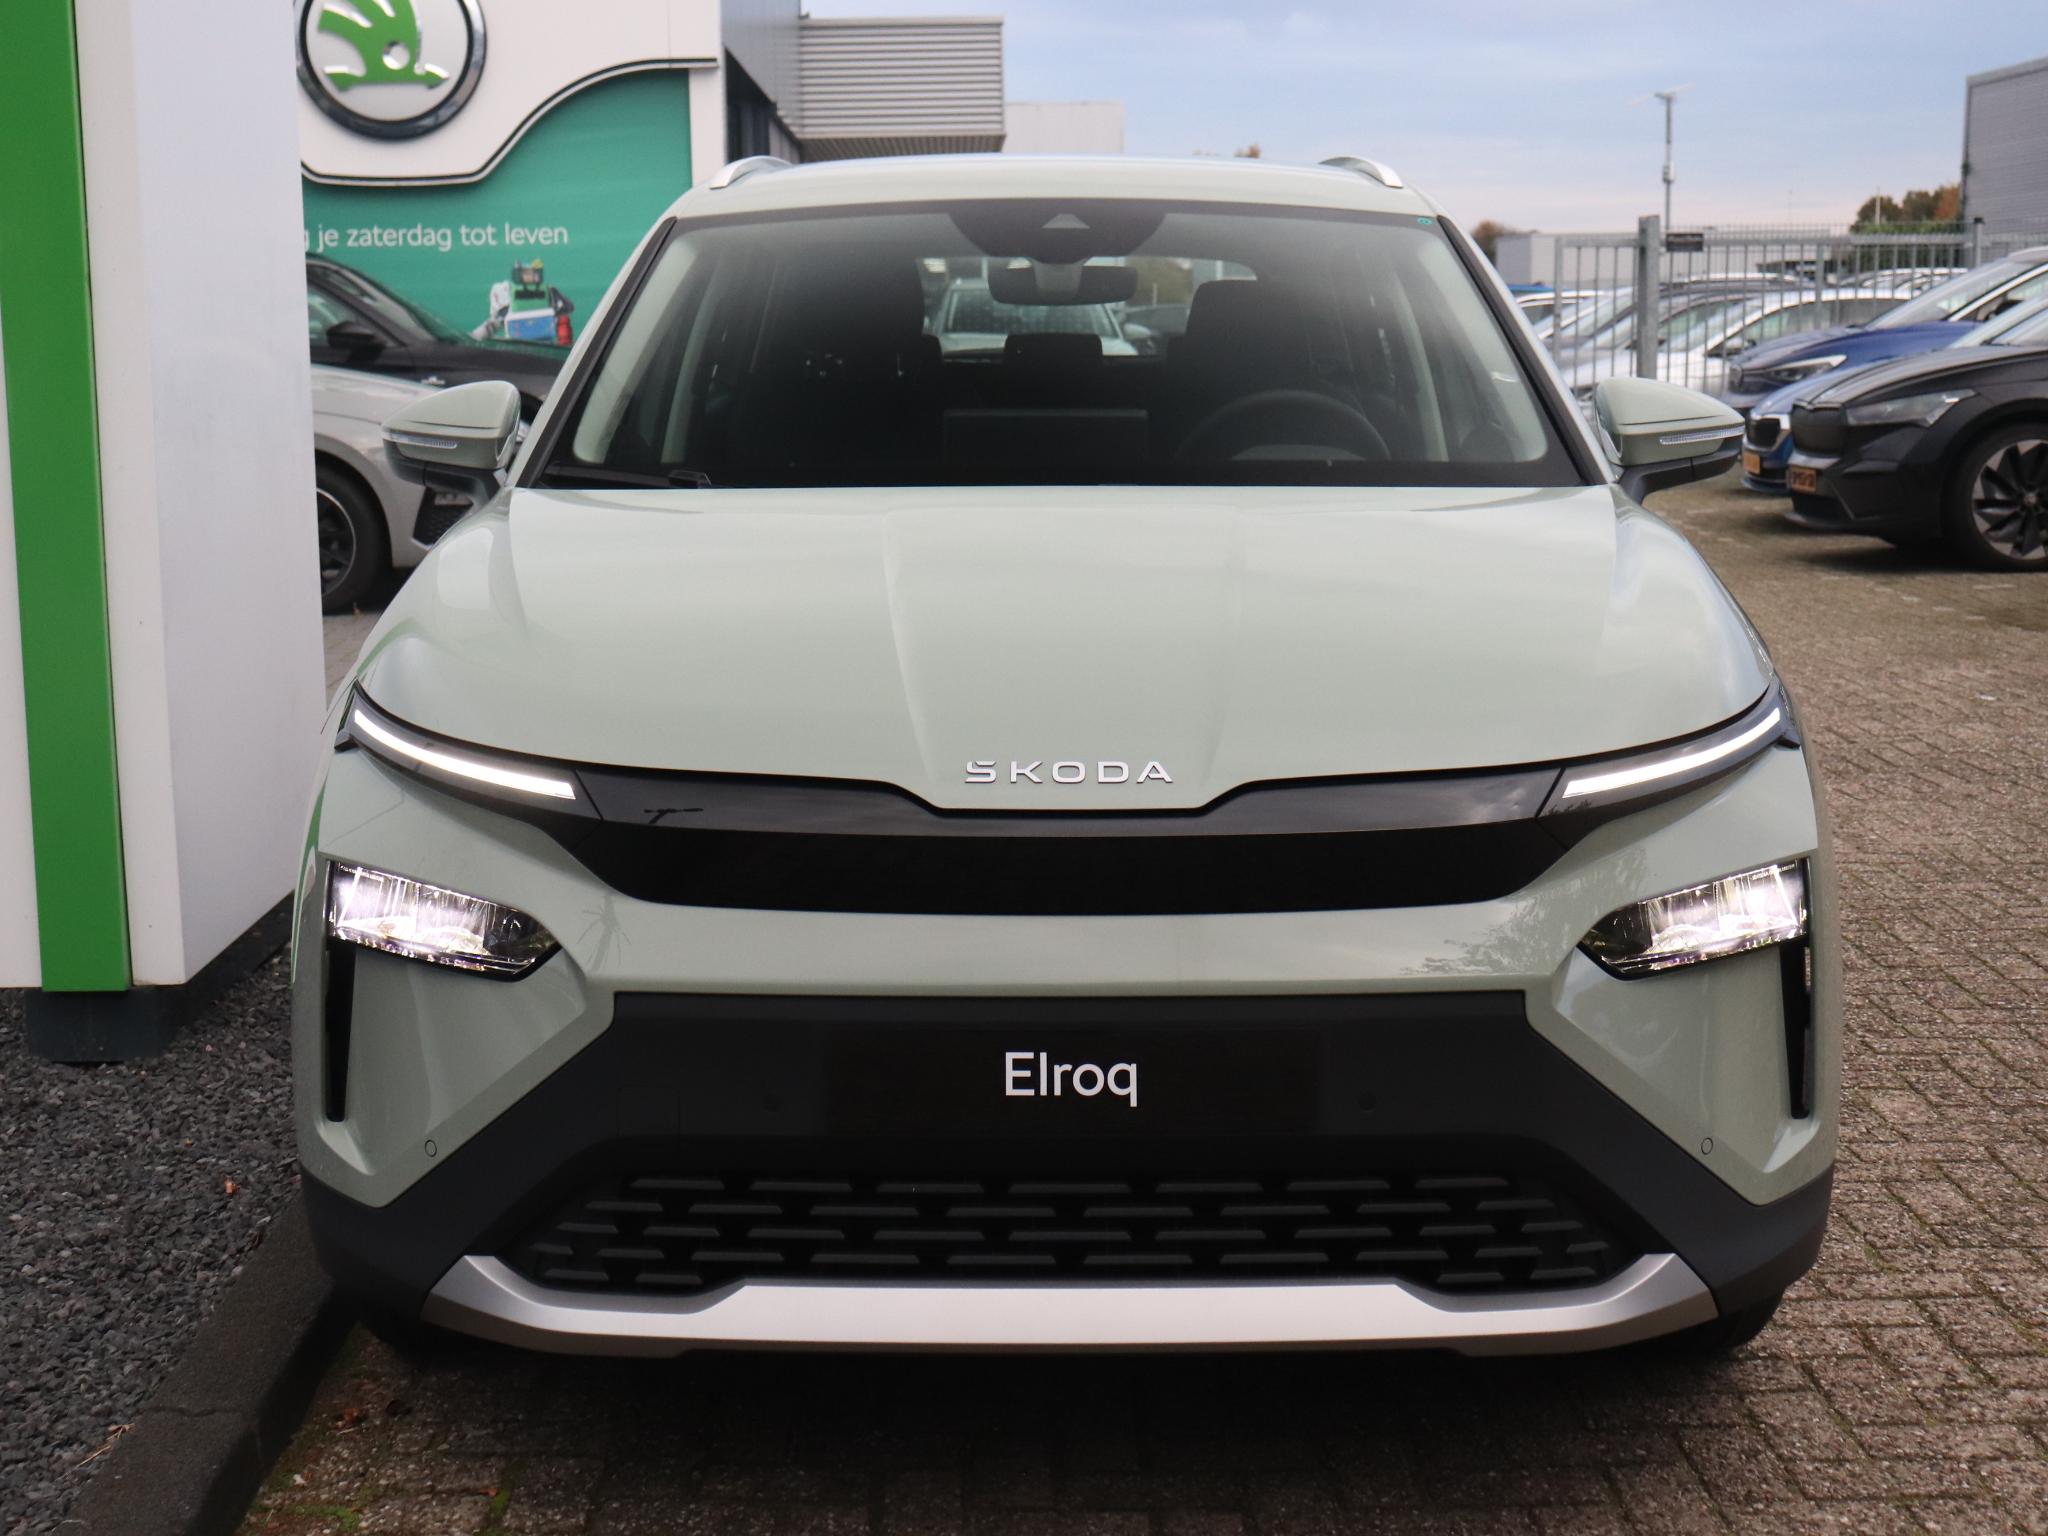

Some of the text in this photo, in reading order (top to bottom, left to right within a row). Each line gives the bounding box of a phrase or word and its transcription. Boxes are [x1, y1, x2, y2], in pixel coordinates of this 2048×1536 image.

[317, 223, 339, 253] je
[346, 222, 452, 252] zaterdag
[459, 224, 497, 246] tot
[504, 221, 568, 246] leven
[1005, 1051, 1138, 1108] Elroq
